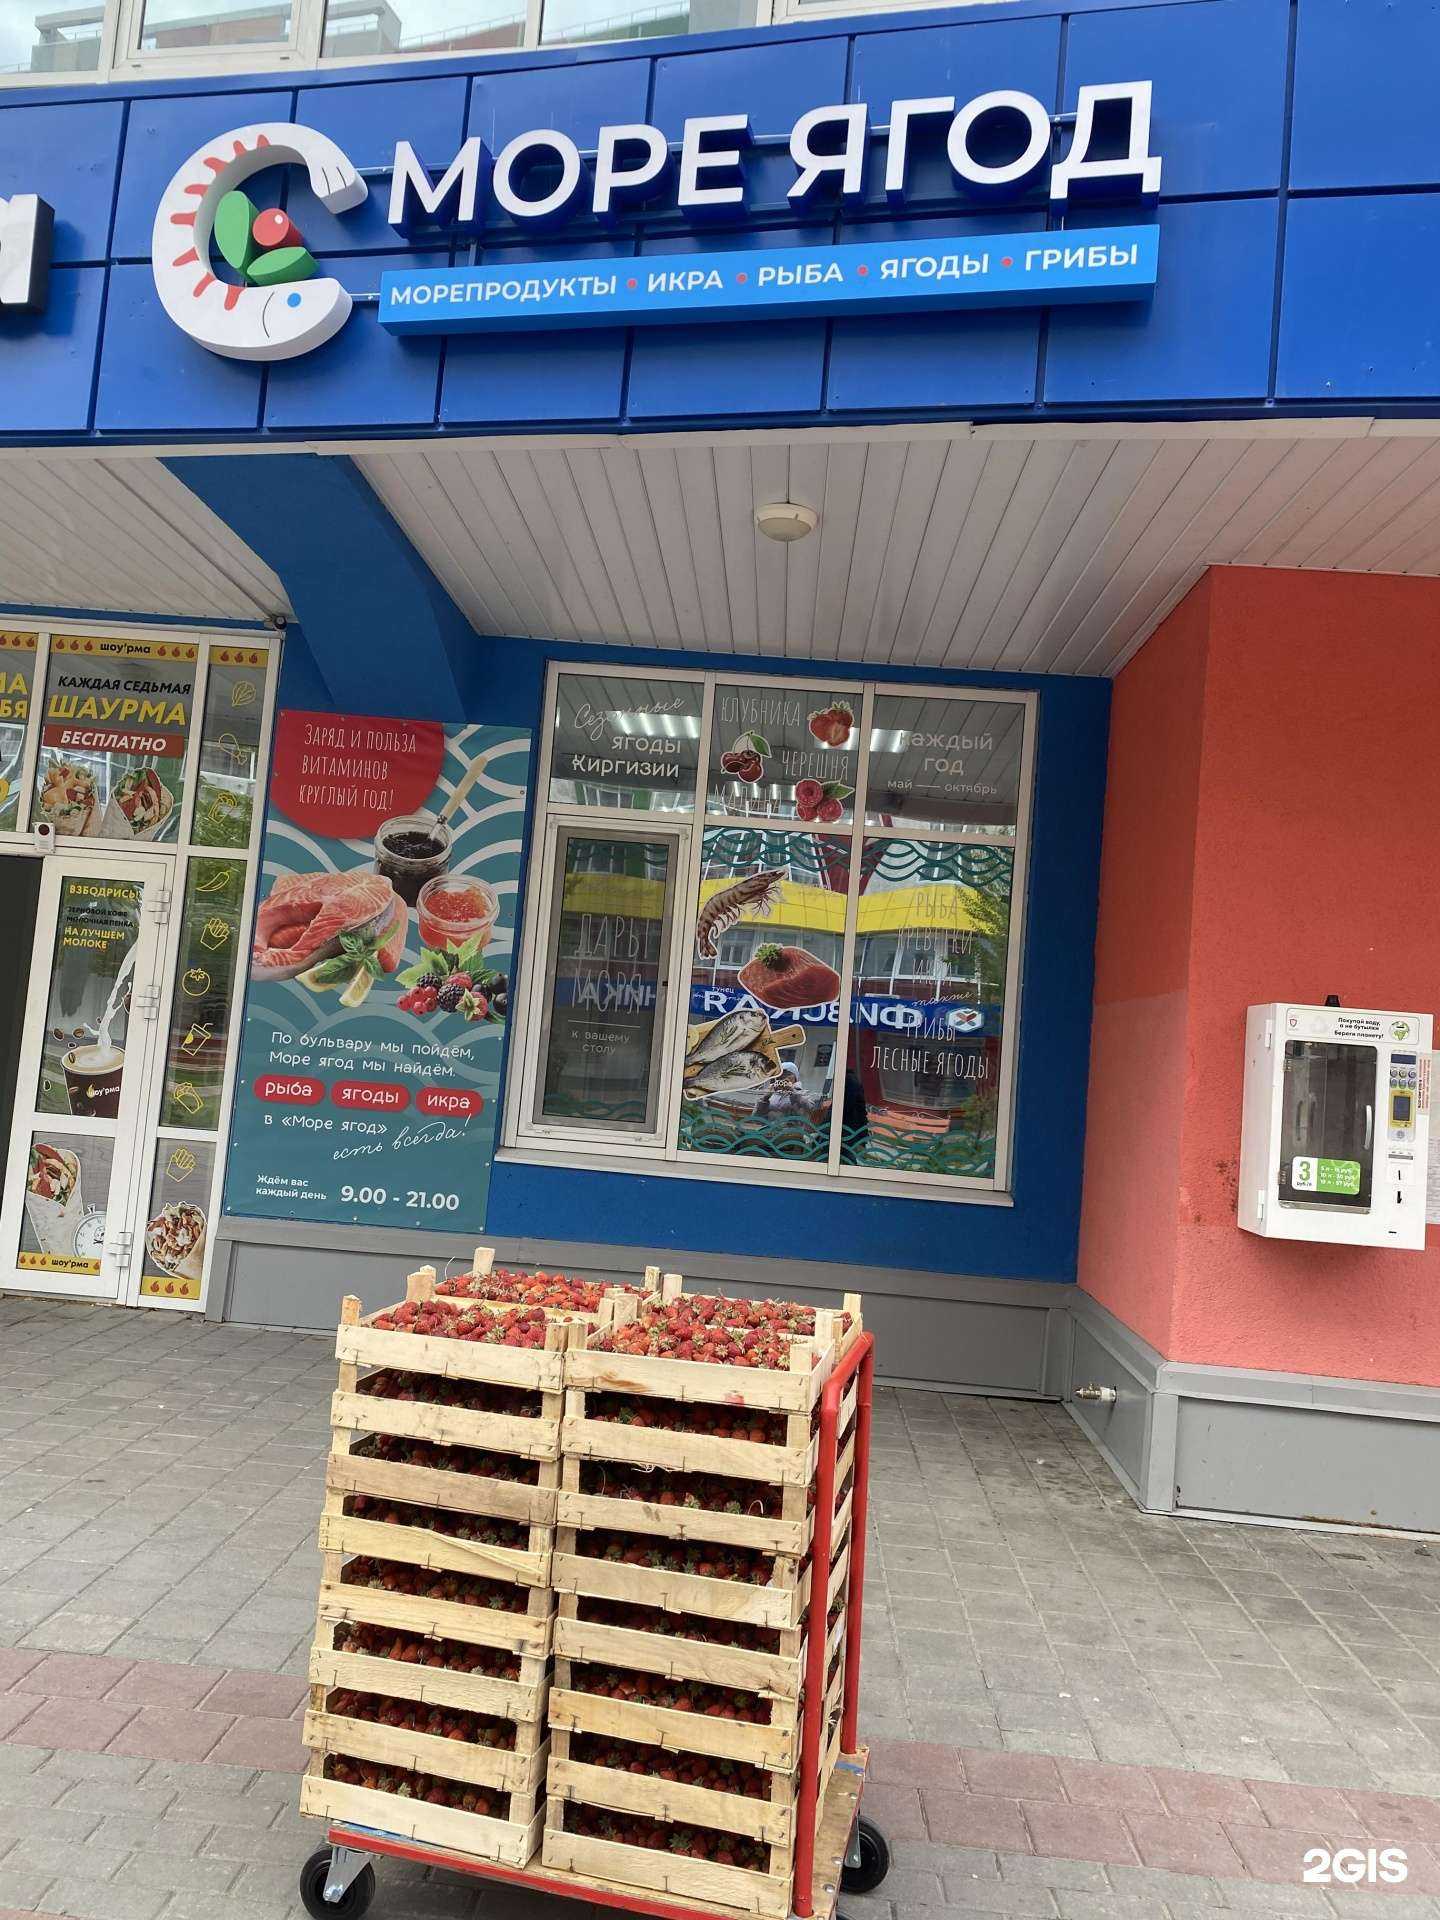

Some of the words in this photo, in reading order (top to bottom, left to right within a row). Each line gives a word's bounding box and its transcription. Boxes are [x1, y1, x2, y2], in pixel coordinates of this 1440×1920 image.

[387, 115, 748, 225] МОРЕ
[787, 80, 1162, 199] ЯГОД
[390, 275, 617, 306] МОРЕПРОДУКТЫ
[648, 270, 723, 292] ИКРА
[758, 263, 843, 287] РЫБА
[880, 253, 990, 280] ЯГОДЫ
[1025, 243, 1138, 271] ГРИБЫ
[58, 676, 120, 691] КАЖДАЯ
[124, 679, 191, 695] СЕДЬМАЯ
[48, 694, 186, 726] ШАУРМА
[721, 696, 800, 727] КЛУБНИКА
[60, 730, 167, 752] БЕСПЛАТНО
[304, 724, 345, 749] ЗАРЯД
[351, 730, 361, 747] И
[366, 732, 417, 753] ПОЛЬЗА
[611, 736, 681, 755] ягоды
[302, 755, 388, 780] ВИТАМИНОВ
[782, 751, 849, 781] ЧЕРЕШНЯ
[923, 758, 964, 776] год
[299, 784, 357, 809] КРУГЛЫЙ
[363, 789, 394, 811] ГОД!
[887, 780, 913, 790] май
[944, 783, 998, 796] октябрь
[63, 937, 107, 949] МОЛОКЕ
[64, 926, 79, 936] НА
[80, 928, 125, 940] ЛУЧШЕМ
[574, 913, 650, 960] ДАРЫ
[572, 967, 642, 1016] МОРЯ
[271, 1032, 292, 1044] По
[300, 1032, 372, 1054] бульвару
[380, 1042, 404, 1053] мы
[585, 1032, 630, 1044] вашему
[269, 1051, 311, 1068] Море
[318, 1056, 354, 1070] ягод
[363, 1061, 386, 1072] мы
[870, 1046, 930, 1074] ЛЕСНЫЕ
[936, 1051, 989, 1080] ЯГОДЫ
[265, 1081, 313, 1097] рыба
[341, 1088, 399, 1104] ягоды
[427, 1095, 471, 1110] икра
[264, 1116, 273, 1125] в
[281, 1115, 333, 1130] «Море
[341, 1121, 388, 1135] ягод»
[333, 1143, 383, 1160] есть
[392, 1113, 472, 1150] всегда!
[257, 1174, 289, 1187] Ждём
[291, 1179, 309, 1187] вас
[1299, 1161, 1311, 1181] 3
[256, 1187, 299, 1199] каждый
[300, 1191, 328, 1200] день
[341, 1186, 386, 1205] 9.00
[406, 1191, 459, 1210] 21.00
[51, 1259, 89, 1269] шоу'рма
